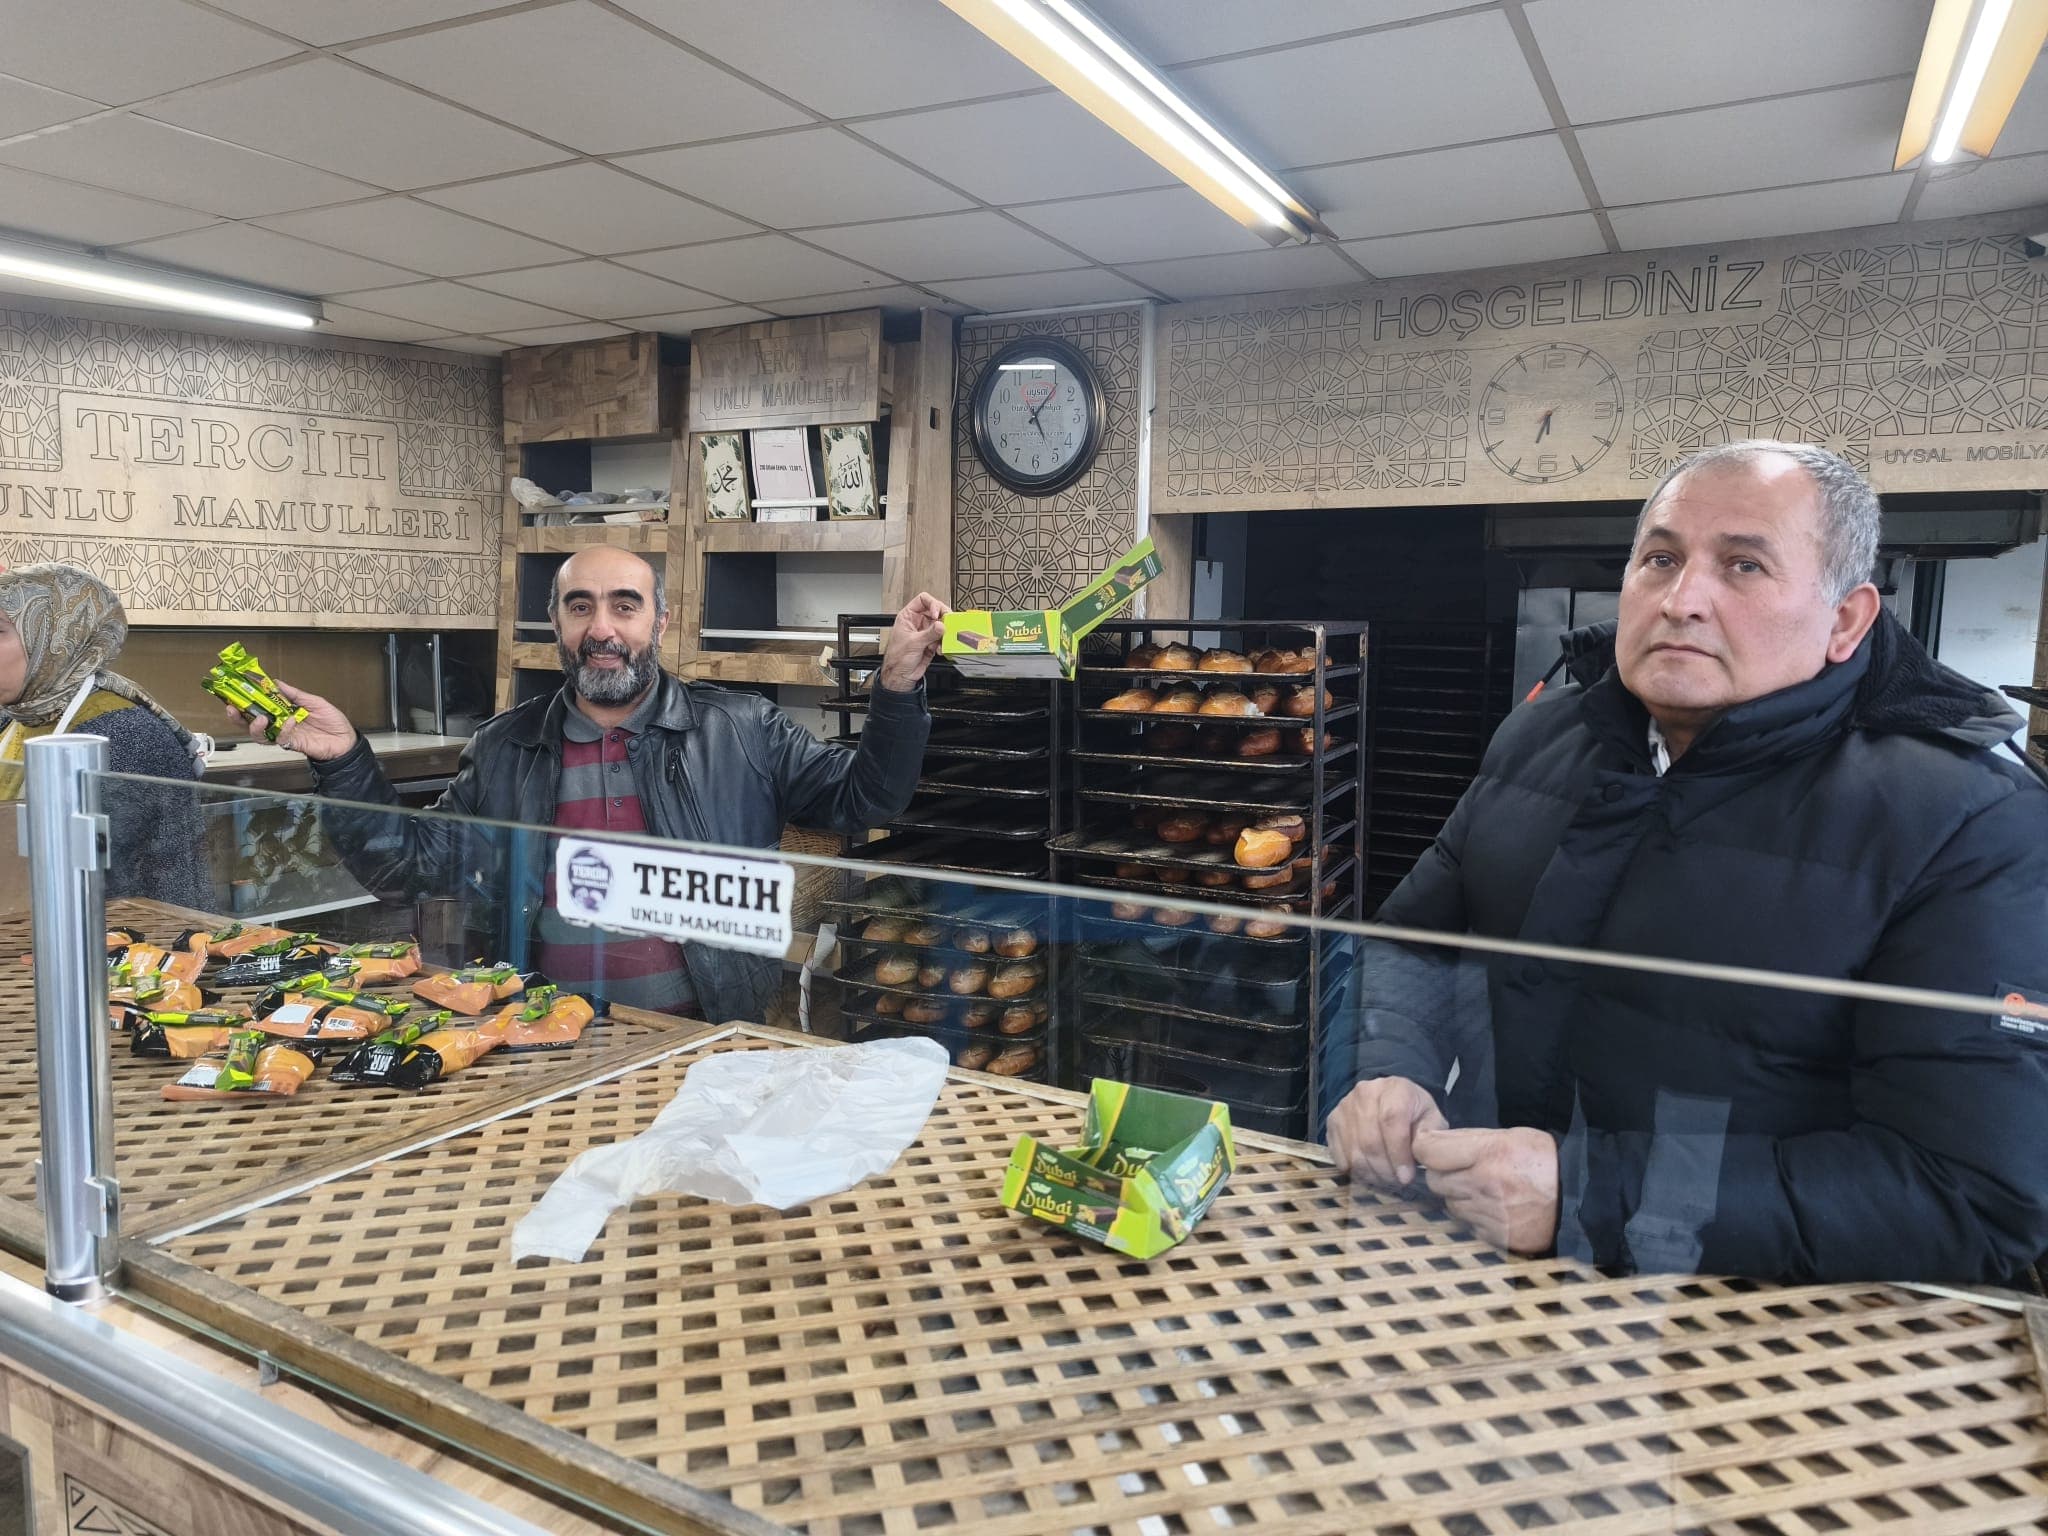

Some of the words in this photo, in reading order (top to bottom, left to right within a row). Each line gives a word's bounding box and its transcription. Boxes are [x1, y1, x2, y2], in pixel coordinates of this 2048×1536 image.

[1373, 255, 1765, 341] HOŞGELDİNİZ
[1542, 351, 1567, 370] 12
[1000, 388, 1011, 404] 10
[1066, 386, 1076, 402] 2
[993, 410, 1001, 426] 9
[1072, 409, 1081, 424] 3
[77, 407, 386, 481] TERCİH
[1000, 433, 1008, 449] 8
[1064, 432, 1073, 449] 4
[1014, 448, 1021, 463] 7
[1032, 454, 1040, 471] 6
[1051, 448, 1059, 463] 5
[1884, 448, 1952, 464] UYSAL
[0, 484, 136, 523] NLU
[173, 494, 471, 541] MAMULLERİ
[1003, 624, 1043, 640] Dubai
[633, 862, 780, 913] TERCİH
[632, 907, 673, 925] UNLU
[1034, 1154, 1078, 1183] Dubai
[1021, 1185, 1073, 1216] Dubai
